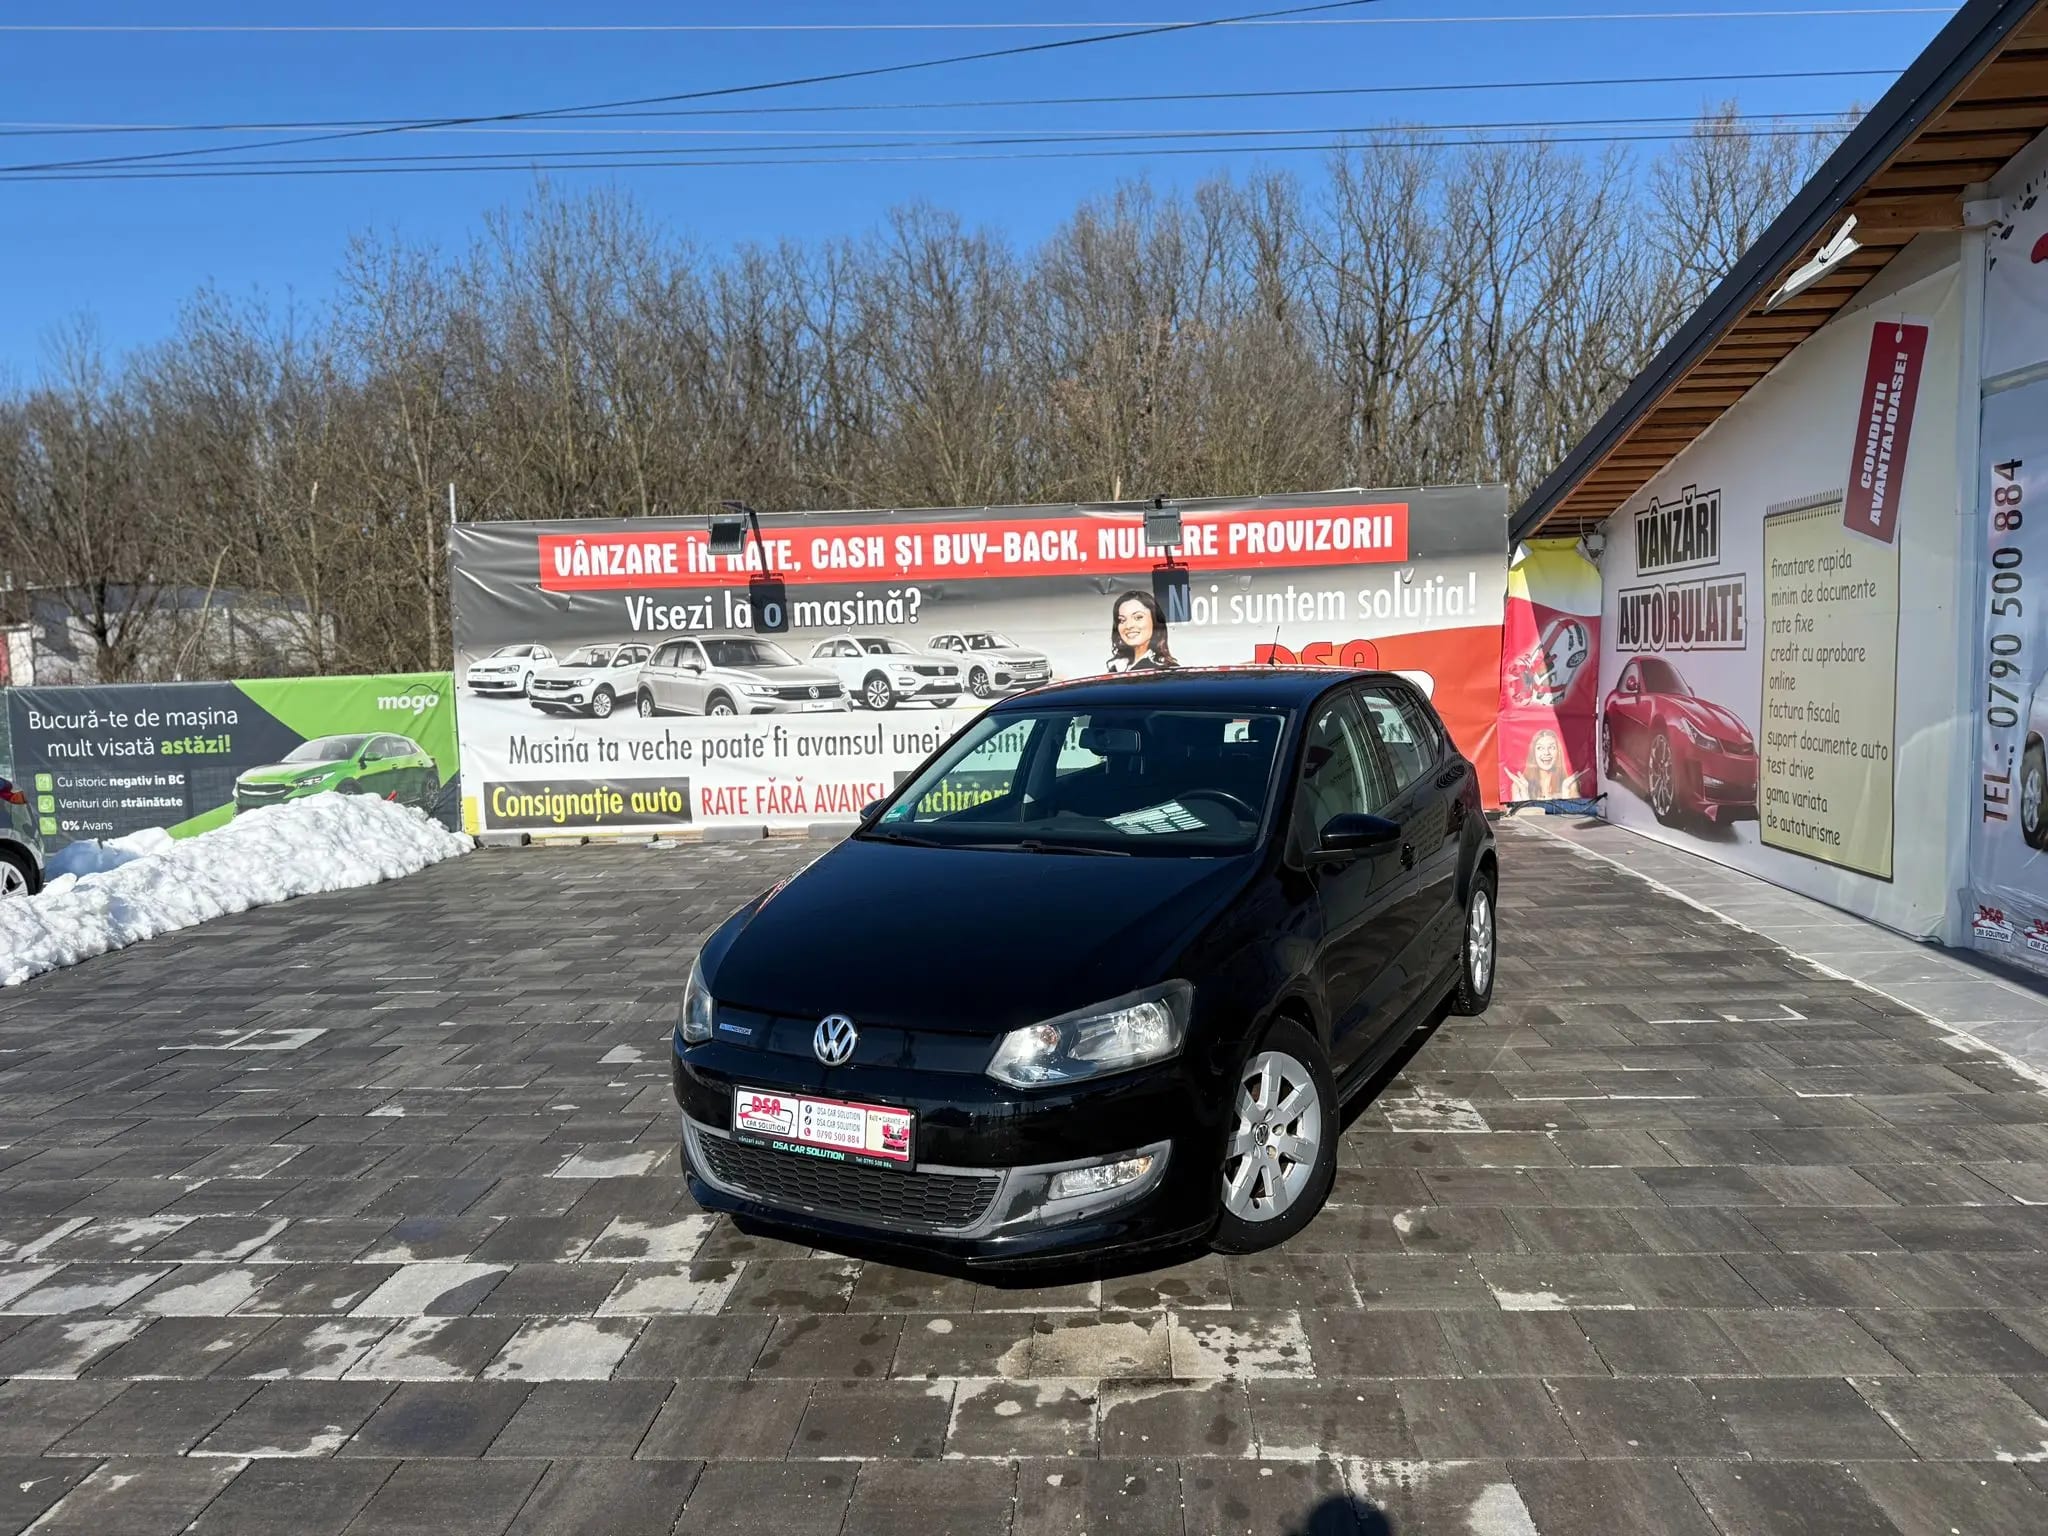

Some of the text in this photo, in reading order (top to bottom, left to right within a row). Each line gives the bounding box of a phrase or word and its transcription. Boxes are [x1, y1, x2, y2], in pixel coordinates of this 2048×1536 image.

[1869, 351, 1909, 527] AVANTAJOASE!
[1993, 458, 2023, 531] 884
[553, 539, 678, 577] VÂNZARE
[687, 535, 716, 573] ÎN
[810, 535, 885, 570] CASH
[895, 534, 923, 575] ȘI
[932, 529, 1088, 565] BUY-BACK,
[1228, 515, 1393, 555] PROVIZORII
[1637, 496, 1718, 570] VÂNZĂRI
[1771, 547, 1852, 579] finantare rapida
[1771, 578, 1877, 607] minim de documente
[1991, 547, 2023, 618] 500
[624, 586, 922, 633] Visezi la o mașină?
[1167, 570, 1477, 626] Noi suntem soluția!
[1619, 582, 1744, 645] AUTO RULATE
[1771, 612, 1814, 635] rate fixe
[1770, 640, 1866, 668] credit cu aprobare
[1769, 670, 1796, 691] online
[1987, 634, 2022, 728] 0790
[28, 706, 239, 730] Bucură-te de mașina
[376, 694, 440, 716] mogo
[1769, 698, 1840, 724] factura fiscala
[47, 734, 232, 757] mult visată astăzi!
[508, 735, 589, 765] Masina
[597, 736, 620, 762] ta
[628, 728, 693, 761] veche
[701, 733, 765, 767] poate
[773, 724, 788, 757] fi
[796, 722, 884, 757] avansul
[892, 725, 941, 754] unei
[1767, 729, 1888, 761] suport documente auto
[57, 776, 73, 788] Cu
[75, 776, 108, 787] istoric
[109, 775, 152, 789] negativ
[168, 774, 185, 786] BC
[1766, 756, 1815, 780] test drive
[58, 796, 184, 809] Venituri din străinătate
[492, 785, 683, 824] Consignație auto
[701, 785, 750, 816] RATE
[756, 776, 808, 815] FĂRĂ
[1766, 787, 1828, 813] gama variata
[61, 820, 113, 831] 0% Avans
[1766, 809, 1841, 846] de autoturisme
[751, 1095, 781, 1116] DSA
[828, 1108, 837, 1117] CAR
[837, 1109, 861, 1120] SOLUTION
[746, 1119, 786, 1132] CAR SOLUTION
[816, 1129, 860, 1144] 0790 500 884
[827, 1119, 836, 1128] CAR
[836, 1121, 860, 1132] SOLUTION
[773, 1141, 845, 1160] DSA CAR SOLUTION
